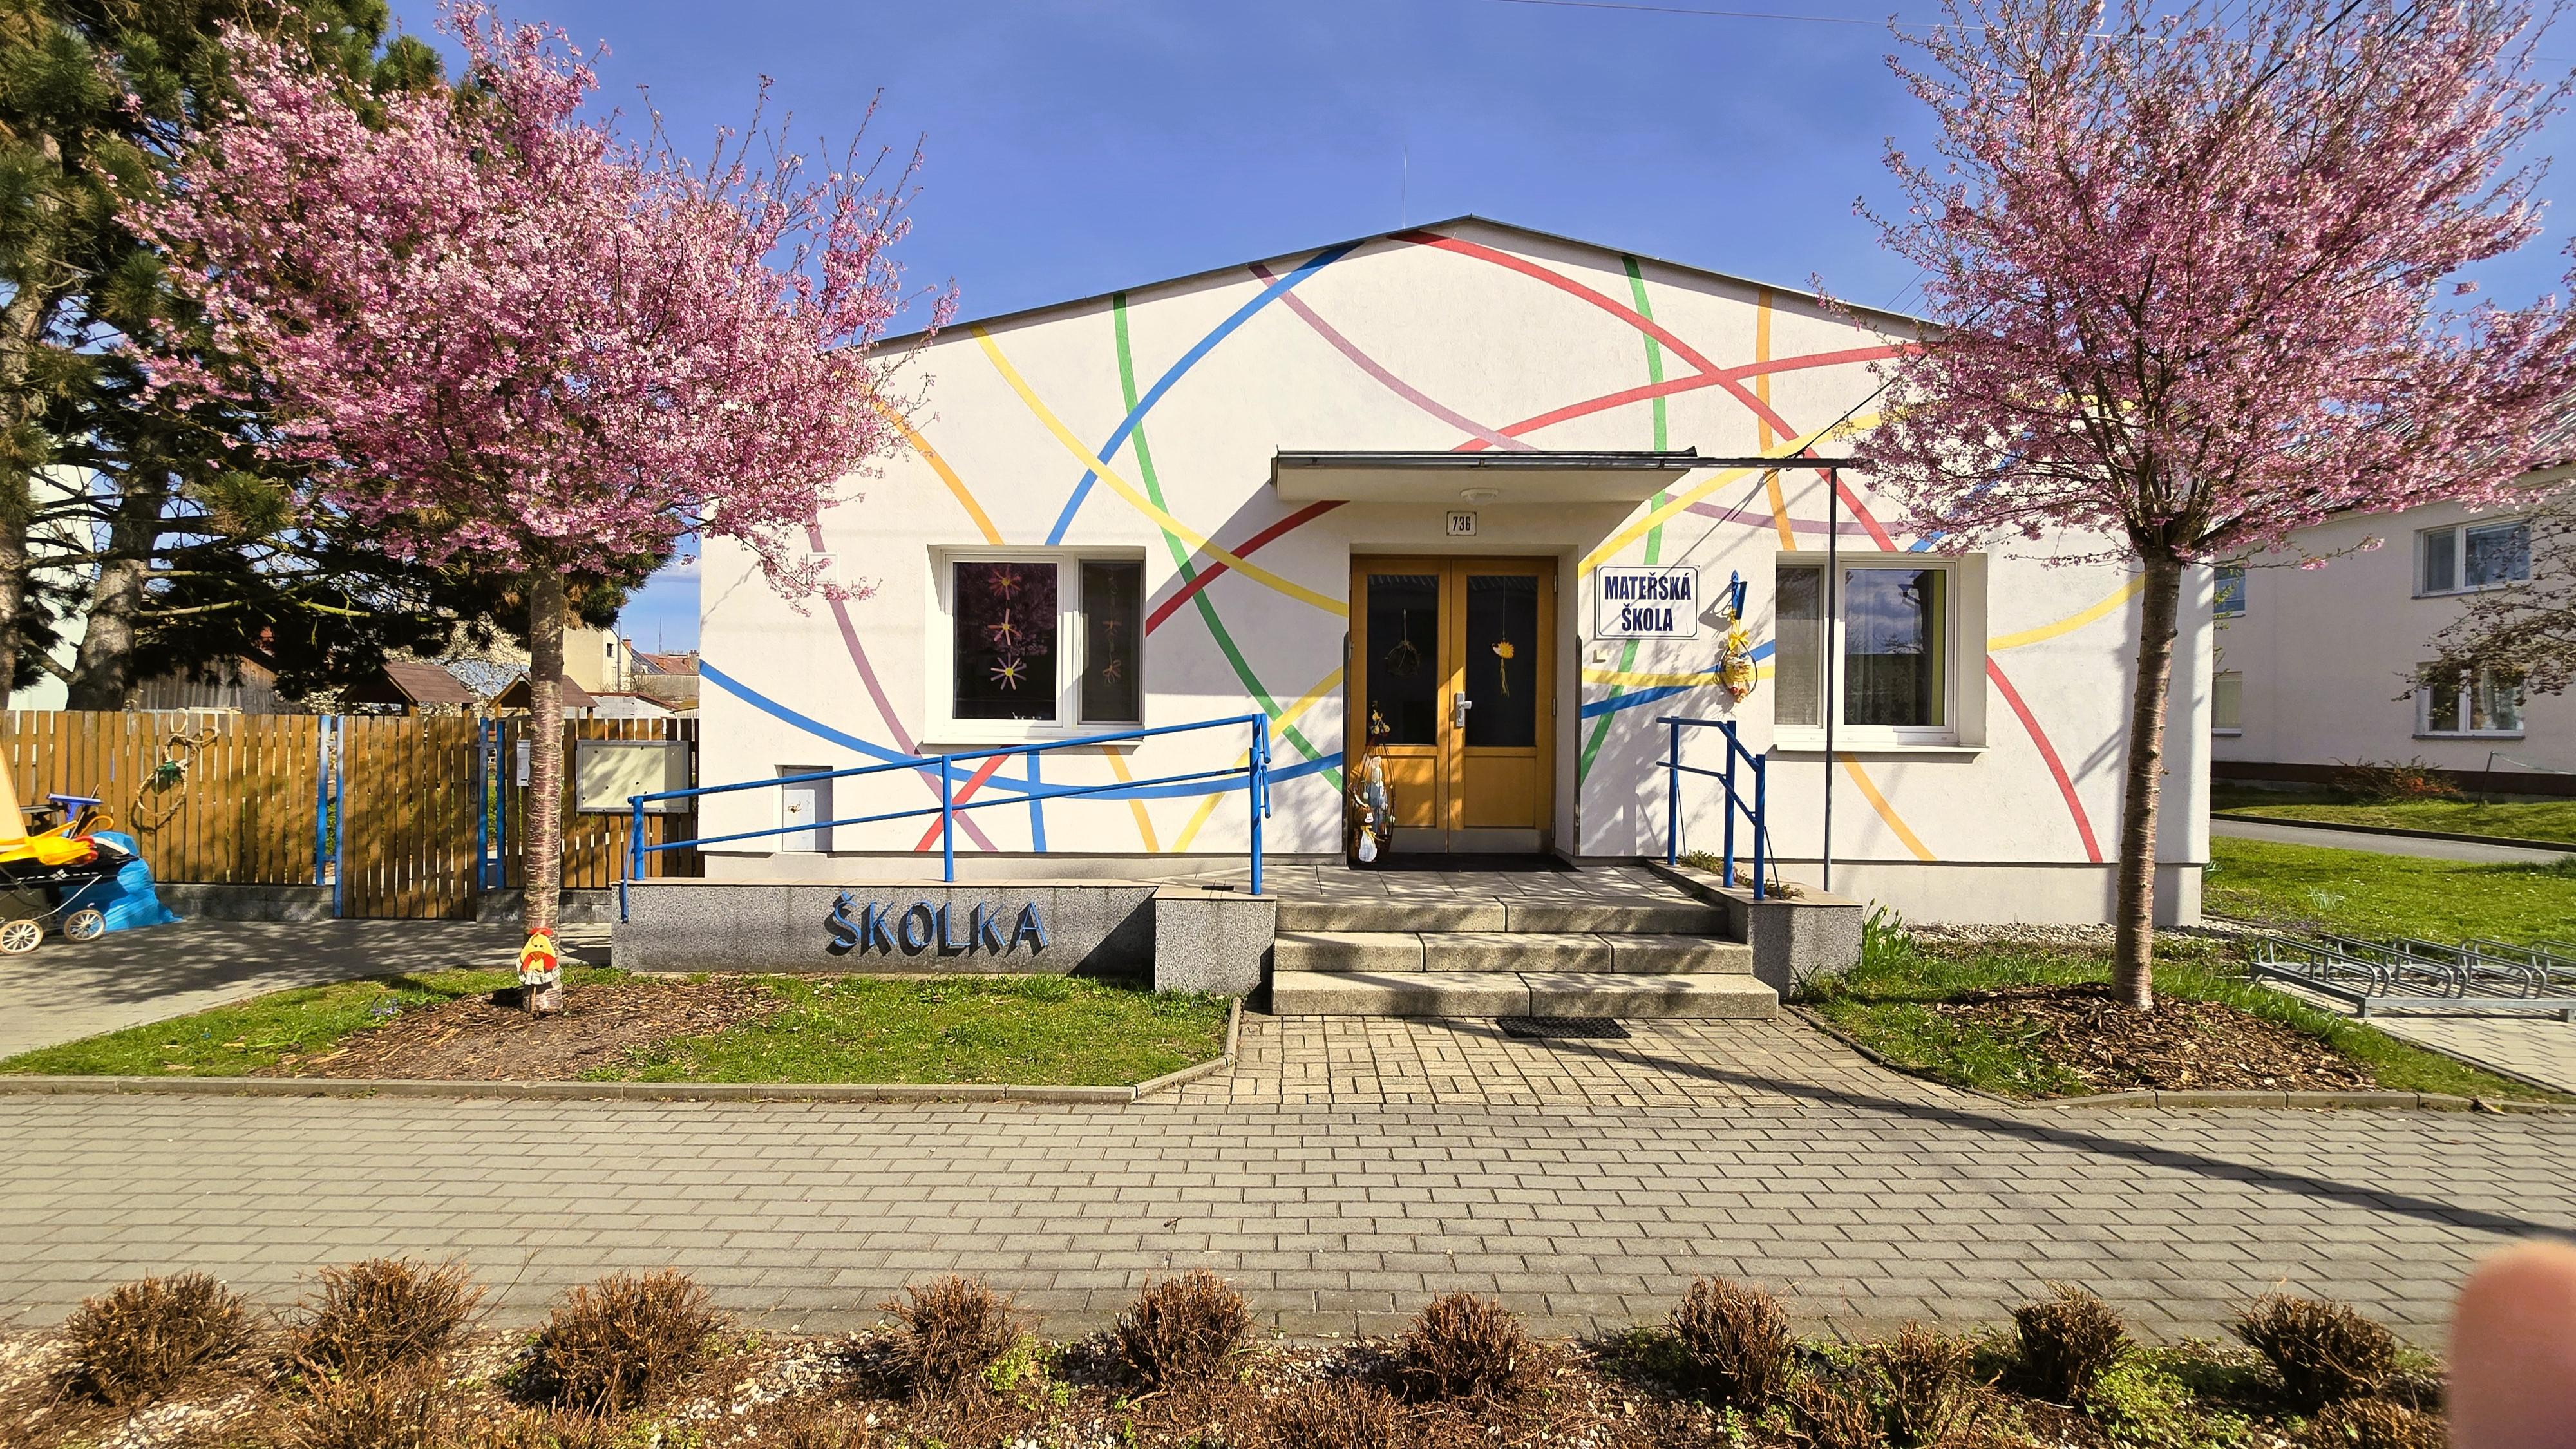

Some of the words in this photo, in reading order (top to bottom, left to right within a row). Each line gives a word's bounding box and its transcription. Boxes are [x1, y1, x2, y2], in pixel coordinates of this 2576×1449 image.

[1453, 516, 1470, 531] 736
[1604, 572, 1691, 600] MATEŘSKÁ
[1621, 603, 1673, 632] ŠKOLA
[834, 891, 1048, 948] ŠKOLKA
